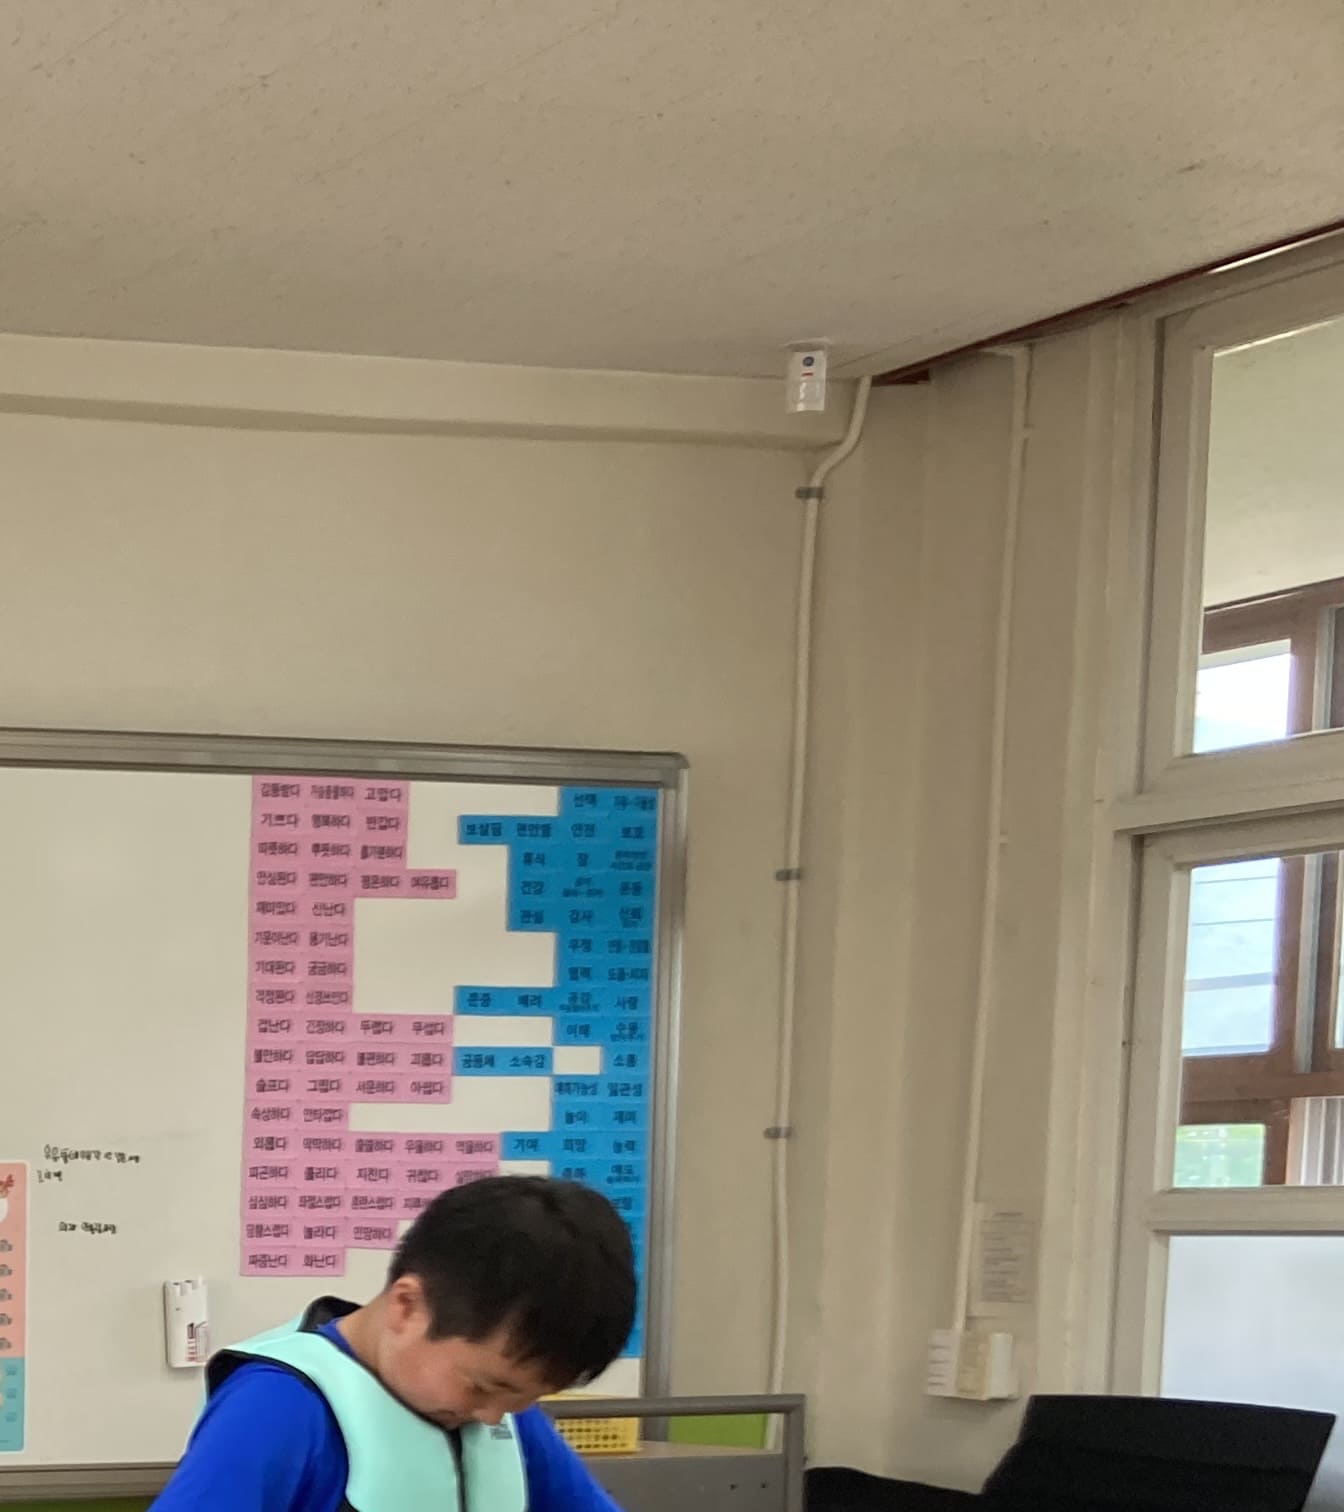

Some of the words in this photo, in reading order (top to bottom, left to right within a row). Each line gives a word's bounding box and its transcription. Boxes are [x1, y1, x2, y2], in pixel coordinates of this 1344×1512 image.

[364, 787, 401, 801] 고맙다
[312, 903, 345, 916] 신난다
[308, 961, 347, 976] 궁금하다
[258, 1019, 292, 1033] 겁난다
[361, 1020, 394, 1035] 두렵다
[413, 1021, 444, 1036] 무섭다
[509, 1055, 545, 1068] 소속감
[256, 1079, 290, 1093] 슬프다
[307, 1079, 342, 1093] 그립다
[251, 1108, 291, 1121] 속상하다
[253, 1136, 288, 1150] 외롭다
[249, 1166, 289, 1179] 피곤하다
[357, 1168, 390, 1182] 지친다
[249, 1196, 287, 1209] 심심하다
[304, 1255, 336, 1268] 화난다
